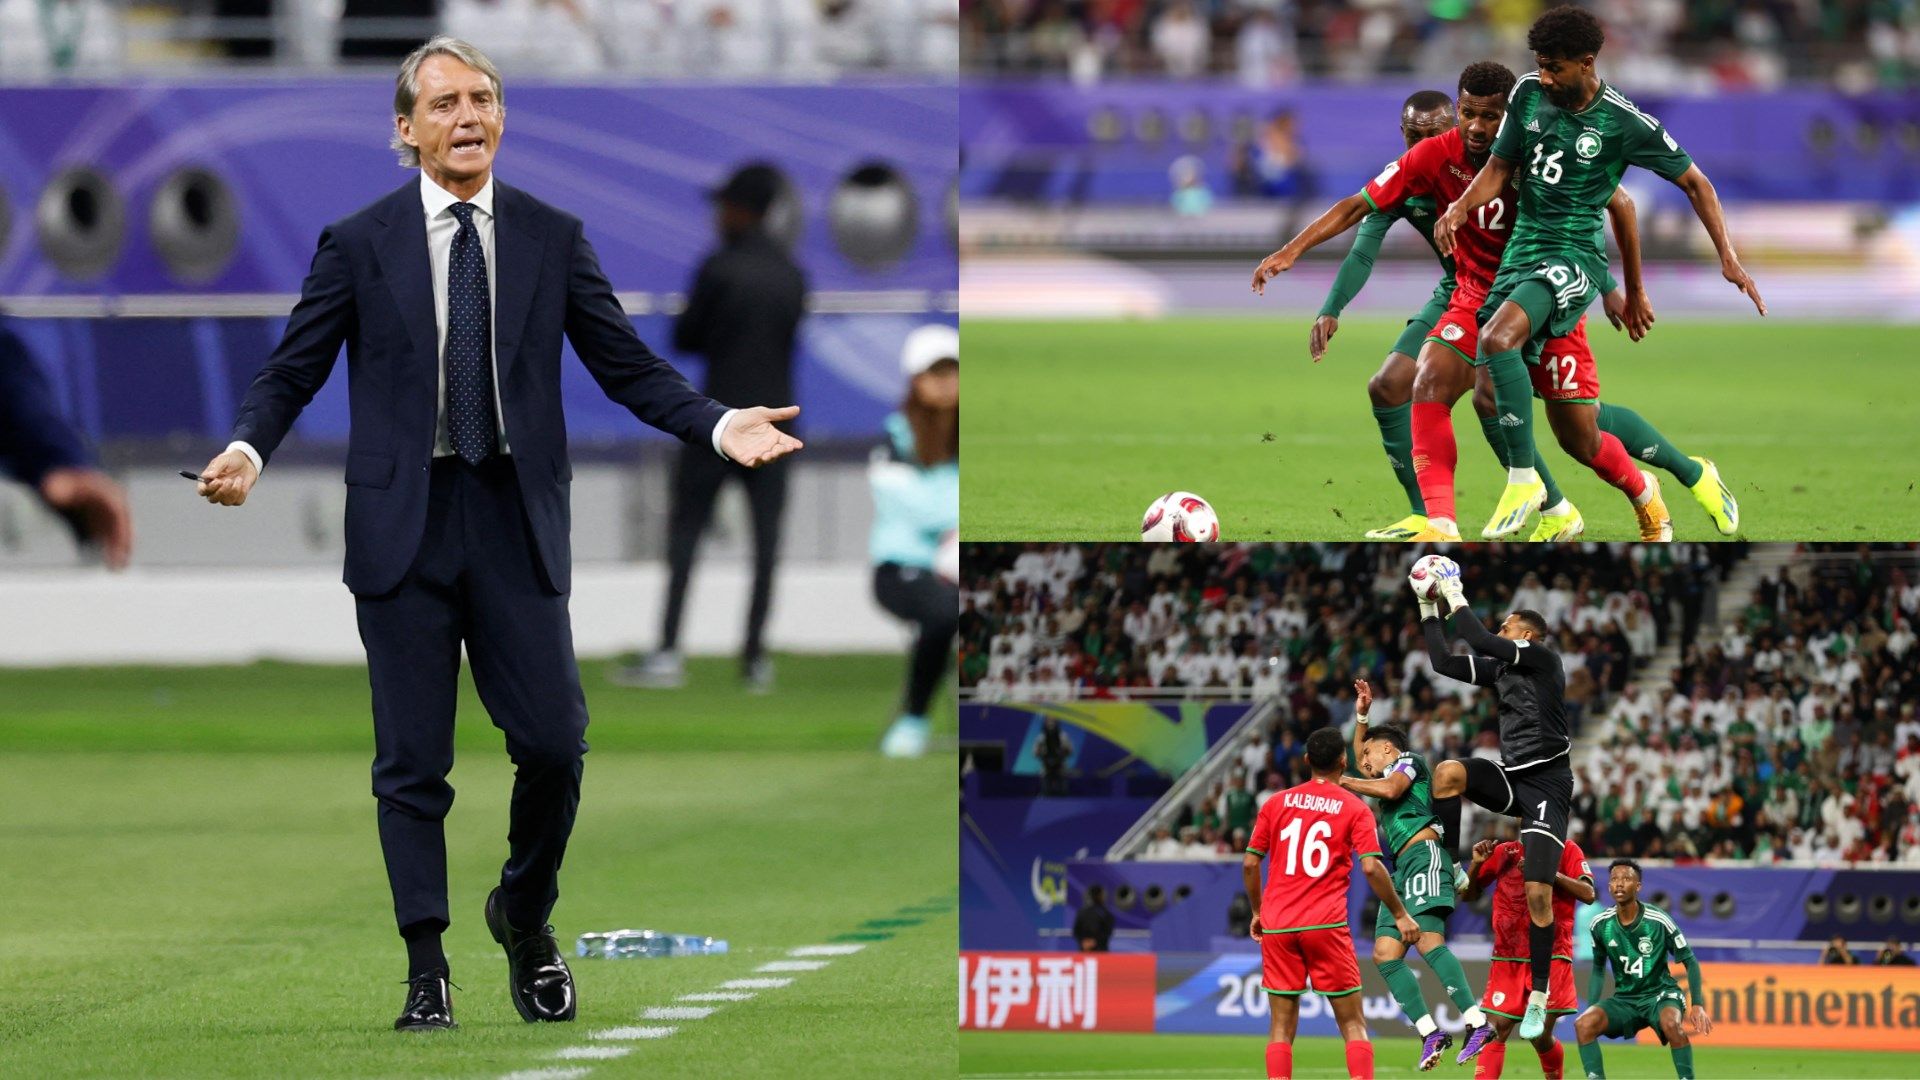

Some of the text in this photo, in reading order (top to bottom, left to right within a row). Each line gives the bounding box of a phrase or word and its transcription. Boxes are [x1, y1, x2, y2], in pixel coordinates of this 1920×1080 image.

[1530, 143, 1564, 184] 16
[1478, 197, 1506, 229] 12
[1546, 354, 1579, 390] 12
[1537, 801, 1547, 820] 1
[1280, 817, 1331, 878] 16
[1405, 872, 1427, 899] 10
[1619, 955, 1643, 978] 24
[959, 956, 1098, 1029] 伊利
[1216, 973, 1323, 1018] 203
[1672, 974, 1920, 1034] ntinenta
